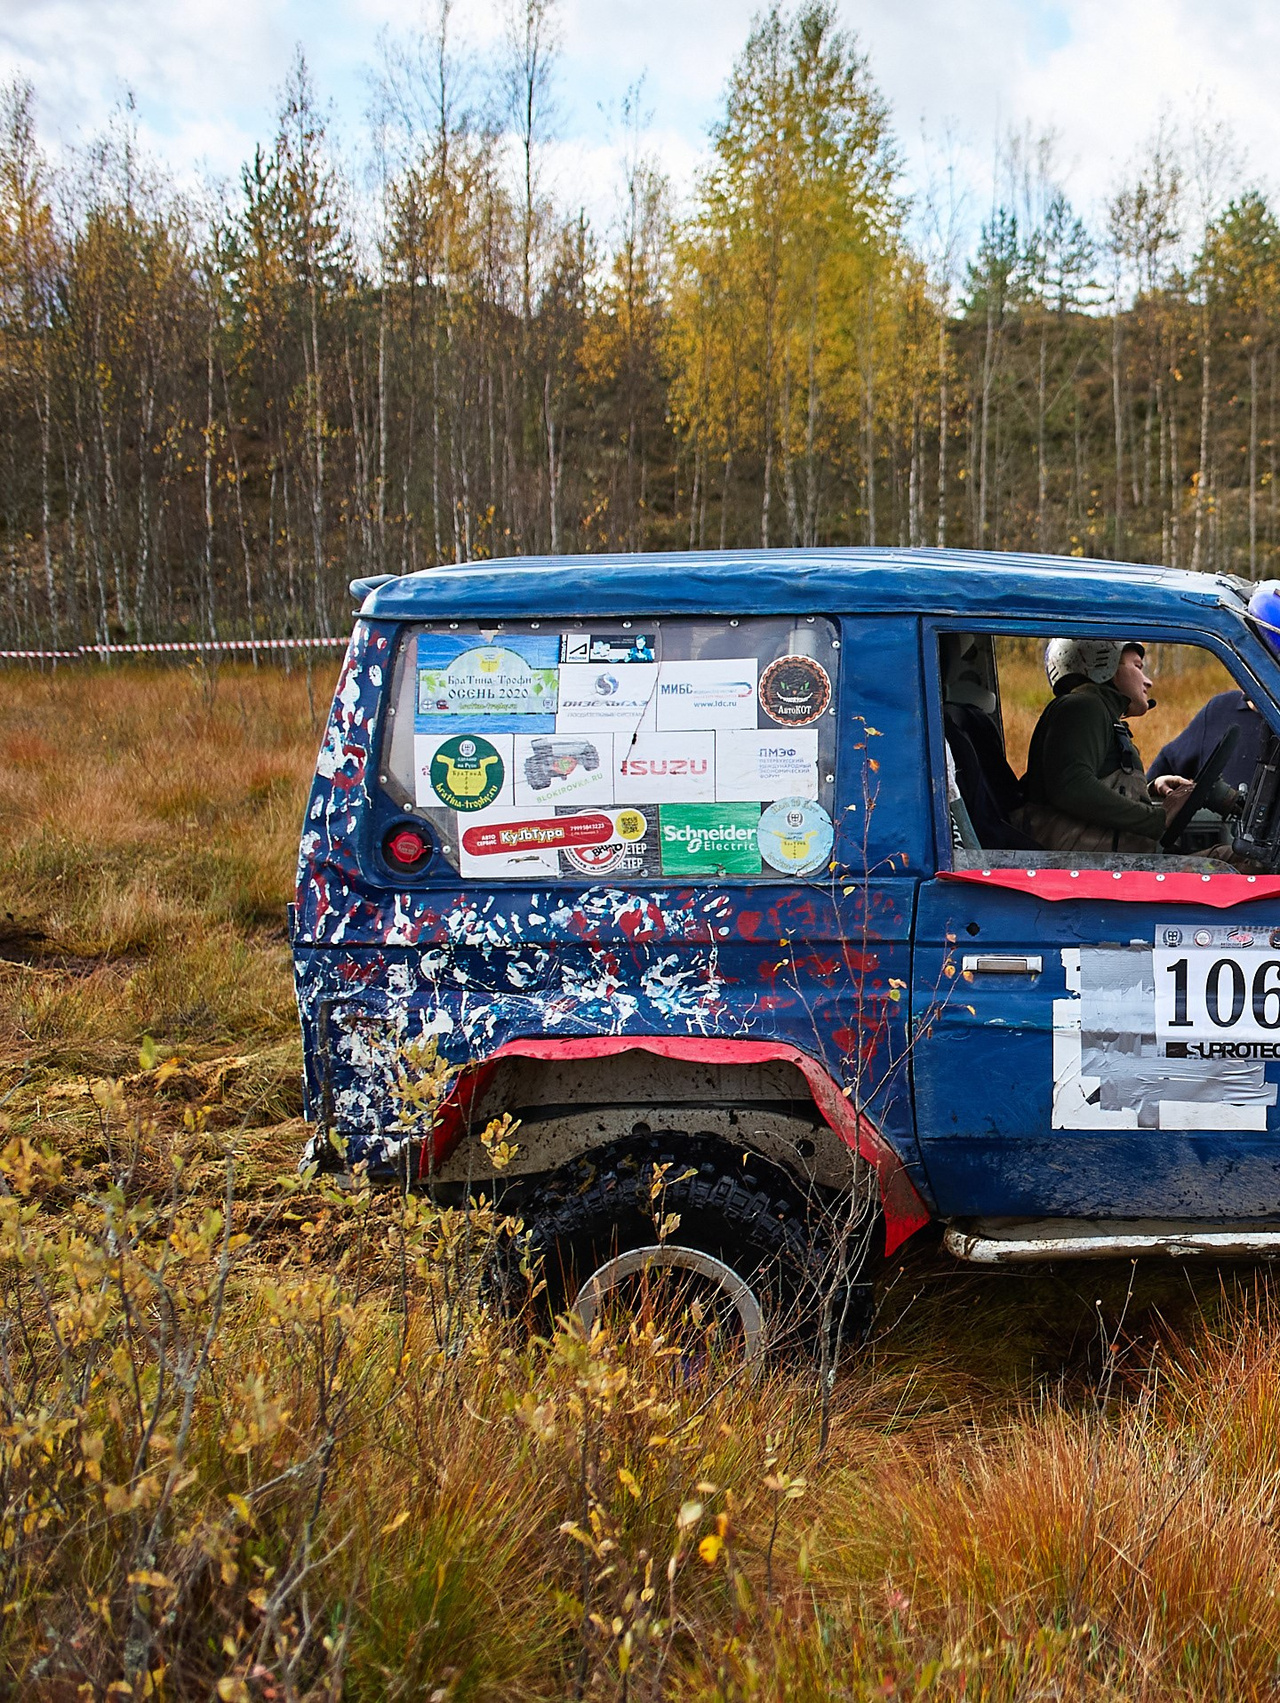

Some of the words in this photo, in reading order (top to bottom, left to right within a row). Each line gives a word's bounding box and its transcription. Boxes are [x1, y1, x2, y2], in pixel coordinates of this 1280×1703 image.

[447, 688, 495, 699] ОСЕНЬ
[499, 688, 529, 699] 2020
[660, 683, 693, 695] МИБС
[777, 705, 812, 715] АвтоКОТ
[759, 747, 797, 758] ПМЭФ
[621, 759, 707, 776] ISUZU
[536, 772, 604, 804] BLOKIROVKA.RU
[663, 825, 757, 842] Schneider
